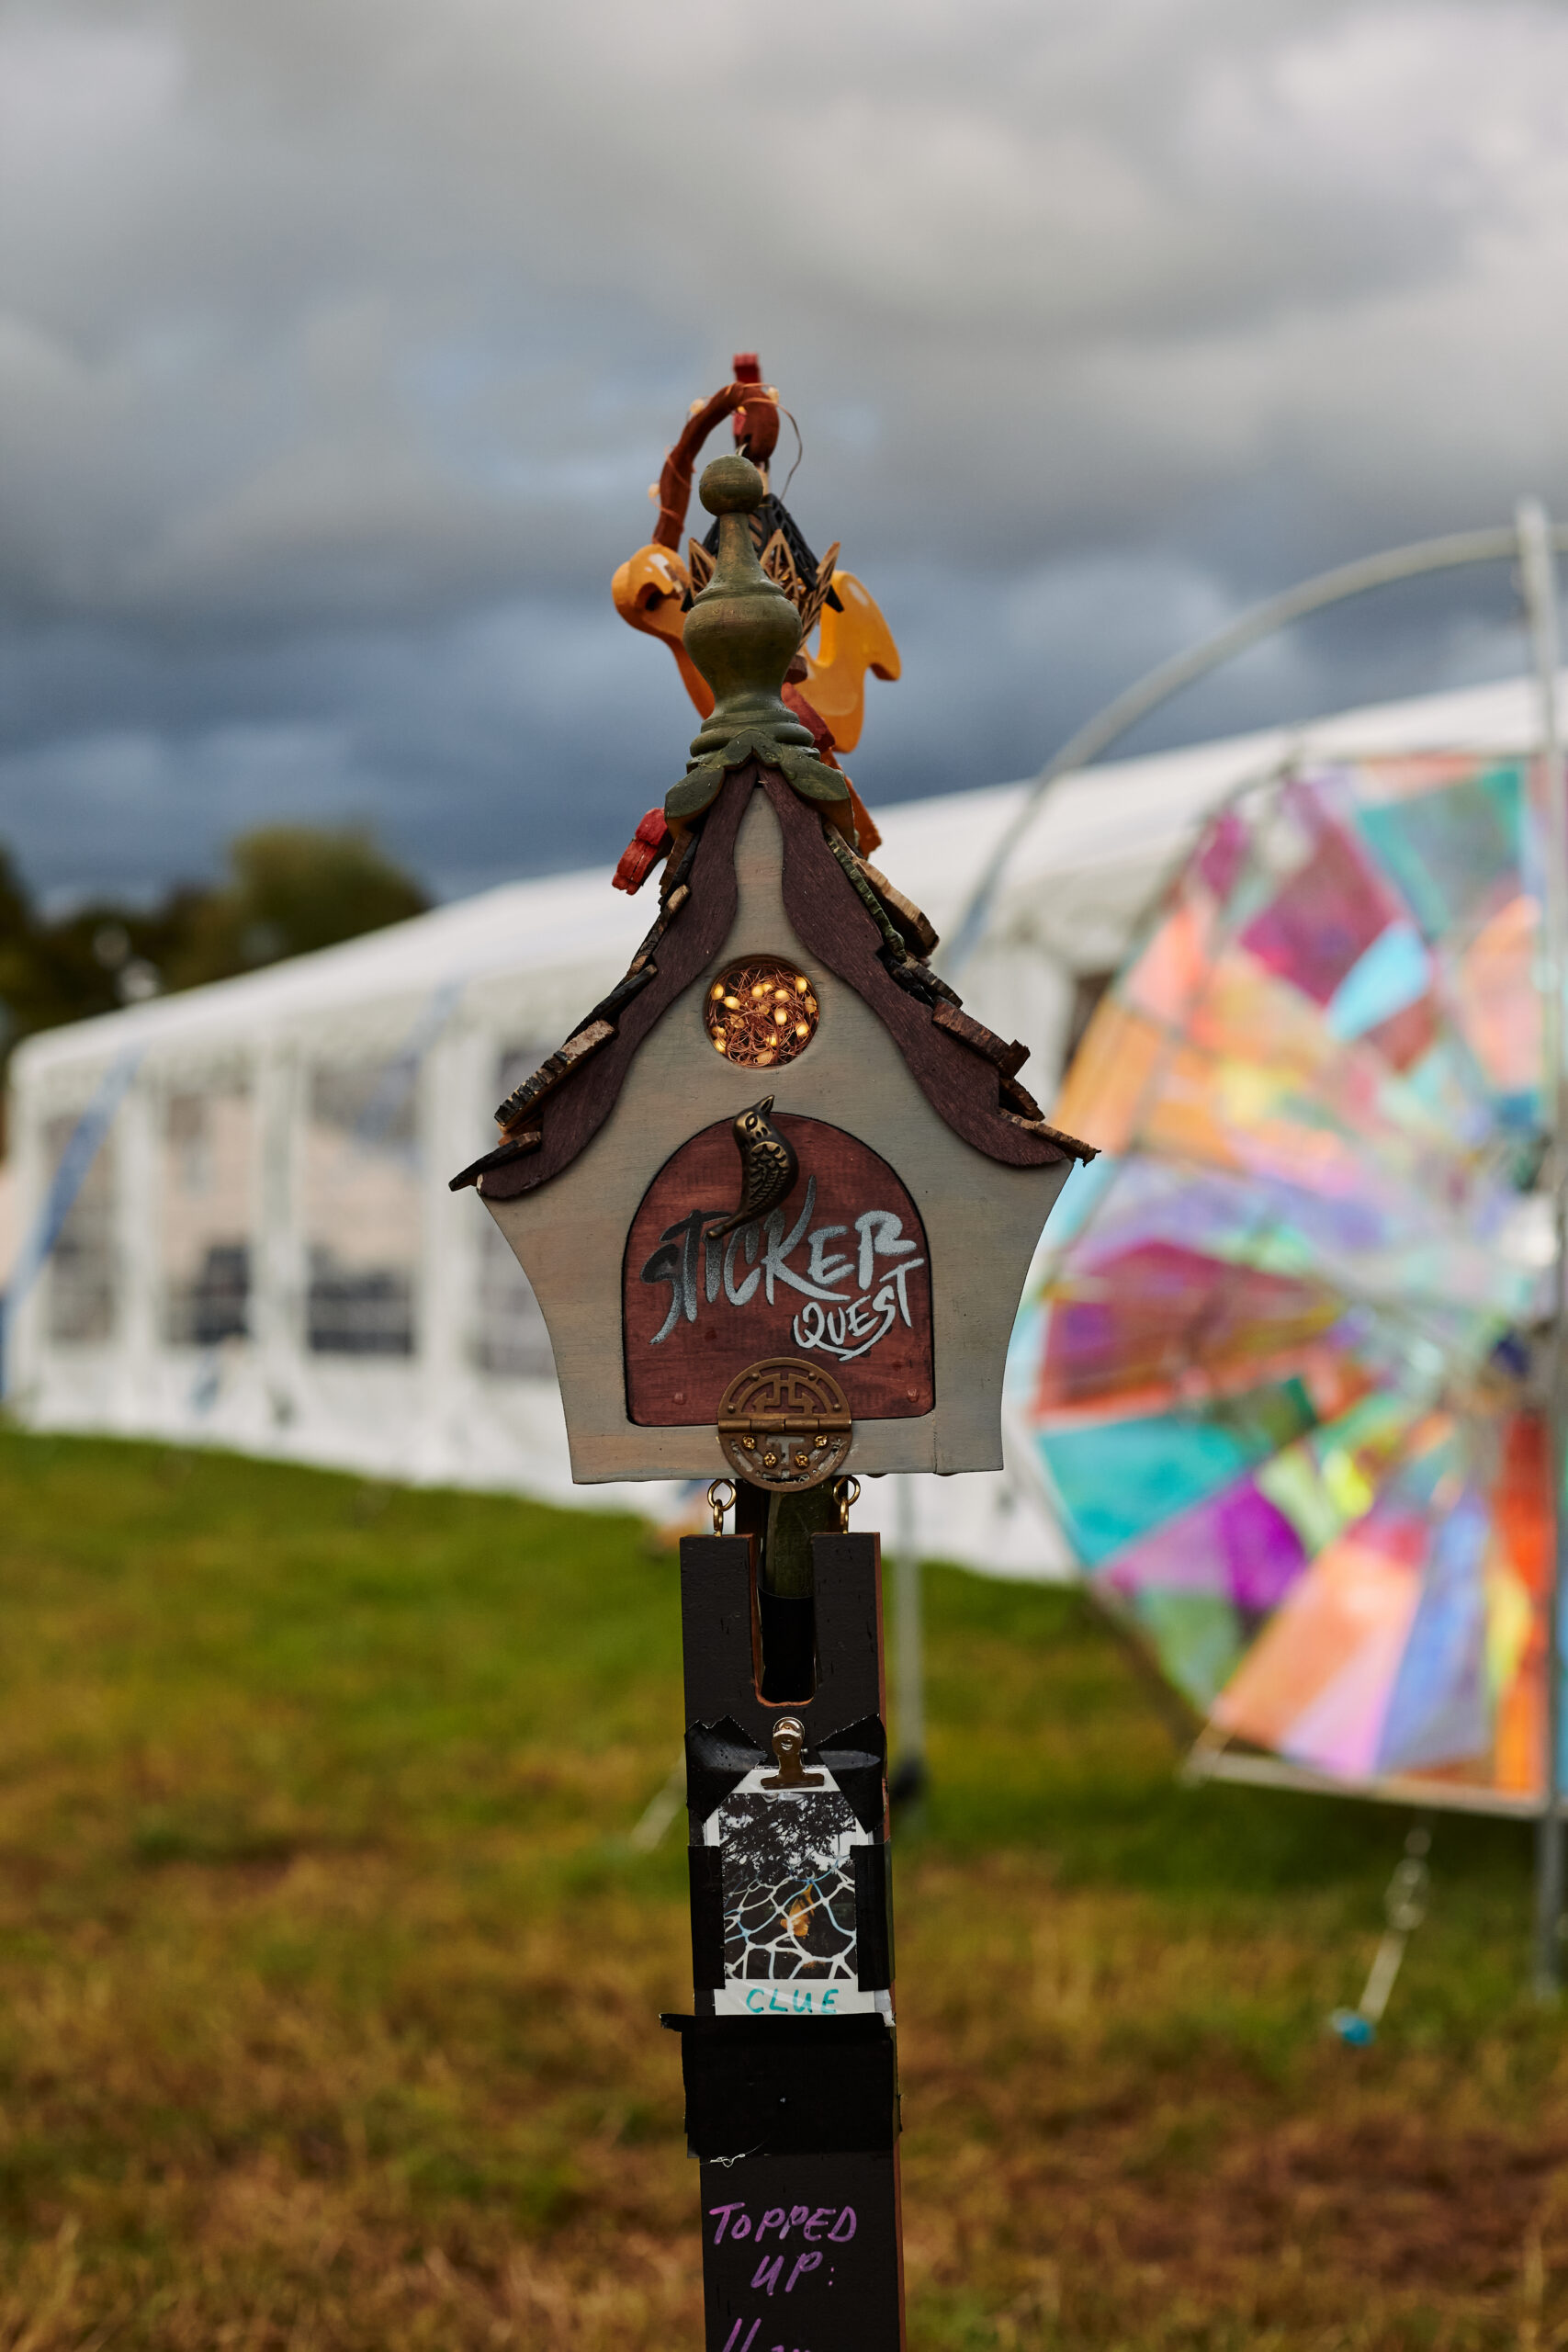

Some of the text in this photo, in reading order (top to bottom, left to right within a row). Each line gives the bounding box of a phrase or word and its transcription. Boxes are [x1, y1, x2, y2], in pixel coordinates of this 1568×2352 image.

[640, 1175, 917, 1345] STICKER
[793, 1258, 924, 1362] QUEST
[746, 1988, 840, 2013] CLUE
[709, 2202, 856, 2245] TOPPED
[750, 2251, 834, 2296] UP:
